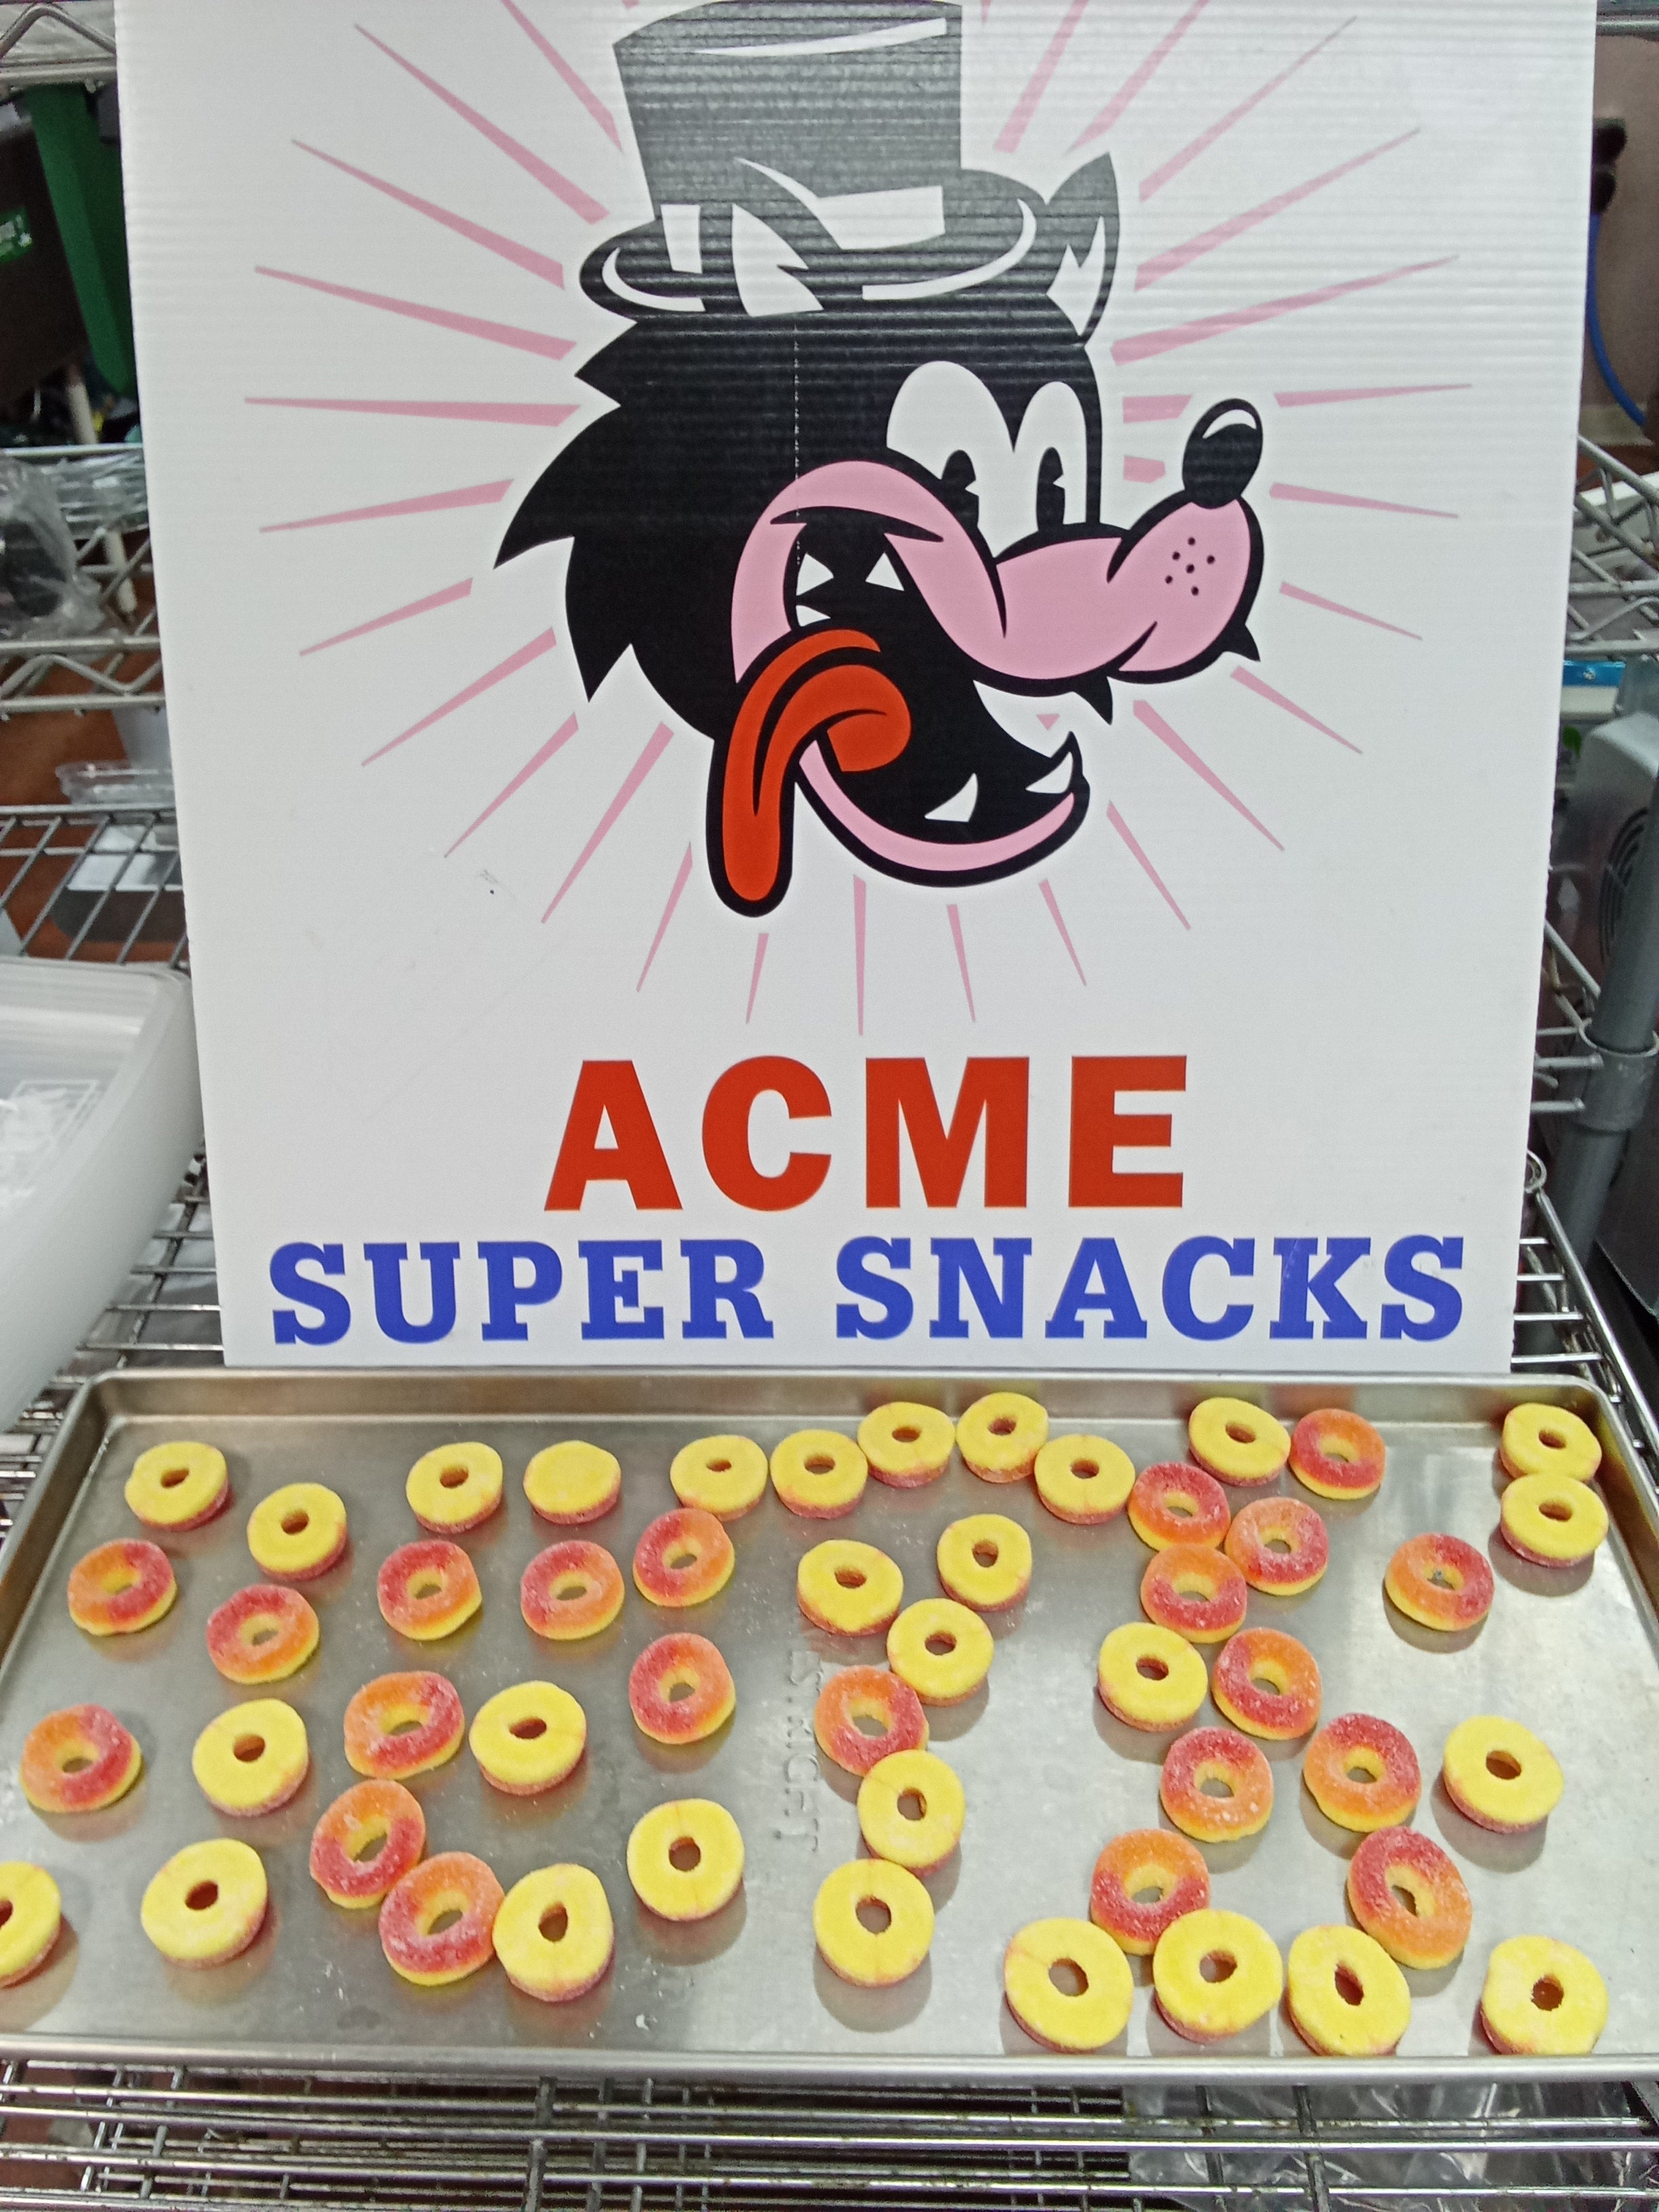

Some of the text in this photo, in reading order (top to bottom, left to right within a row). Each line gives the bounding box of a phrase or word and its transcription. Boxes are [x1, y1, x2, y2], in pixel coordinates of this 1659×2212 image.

[546, 1057, 1187, 1211] ACME
[270, 1236, 1463, 1345] SUPER SNACKS
